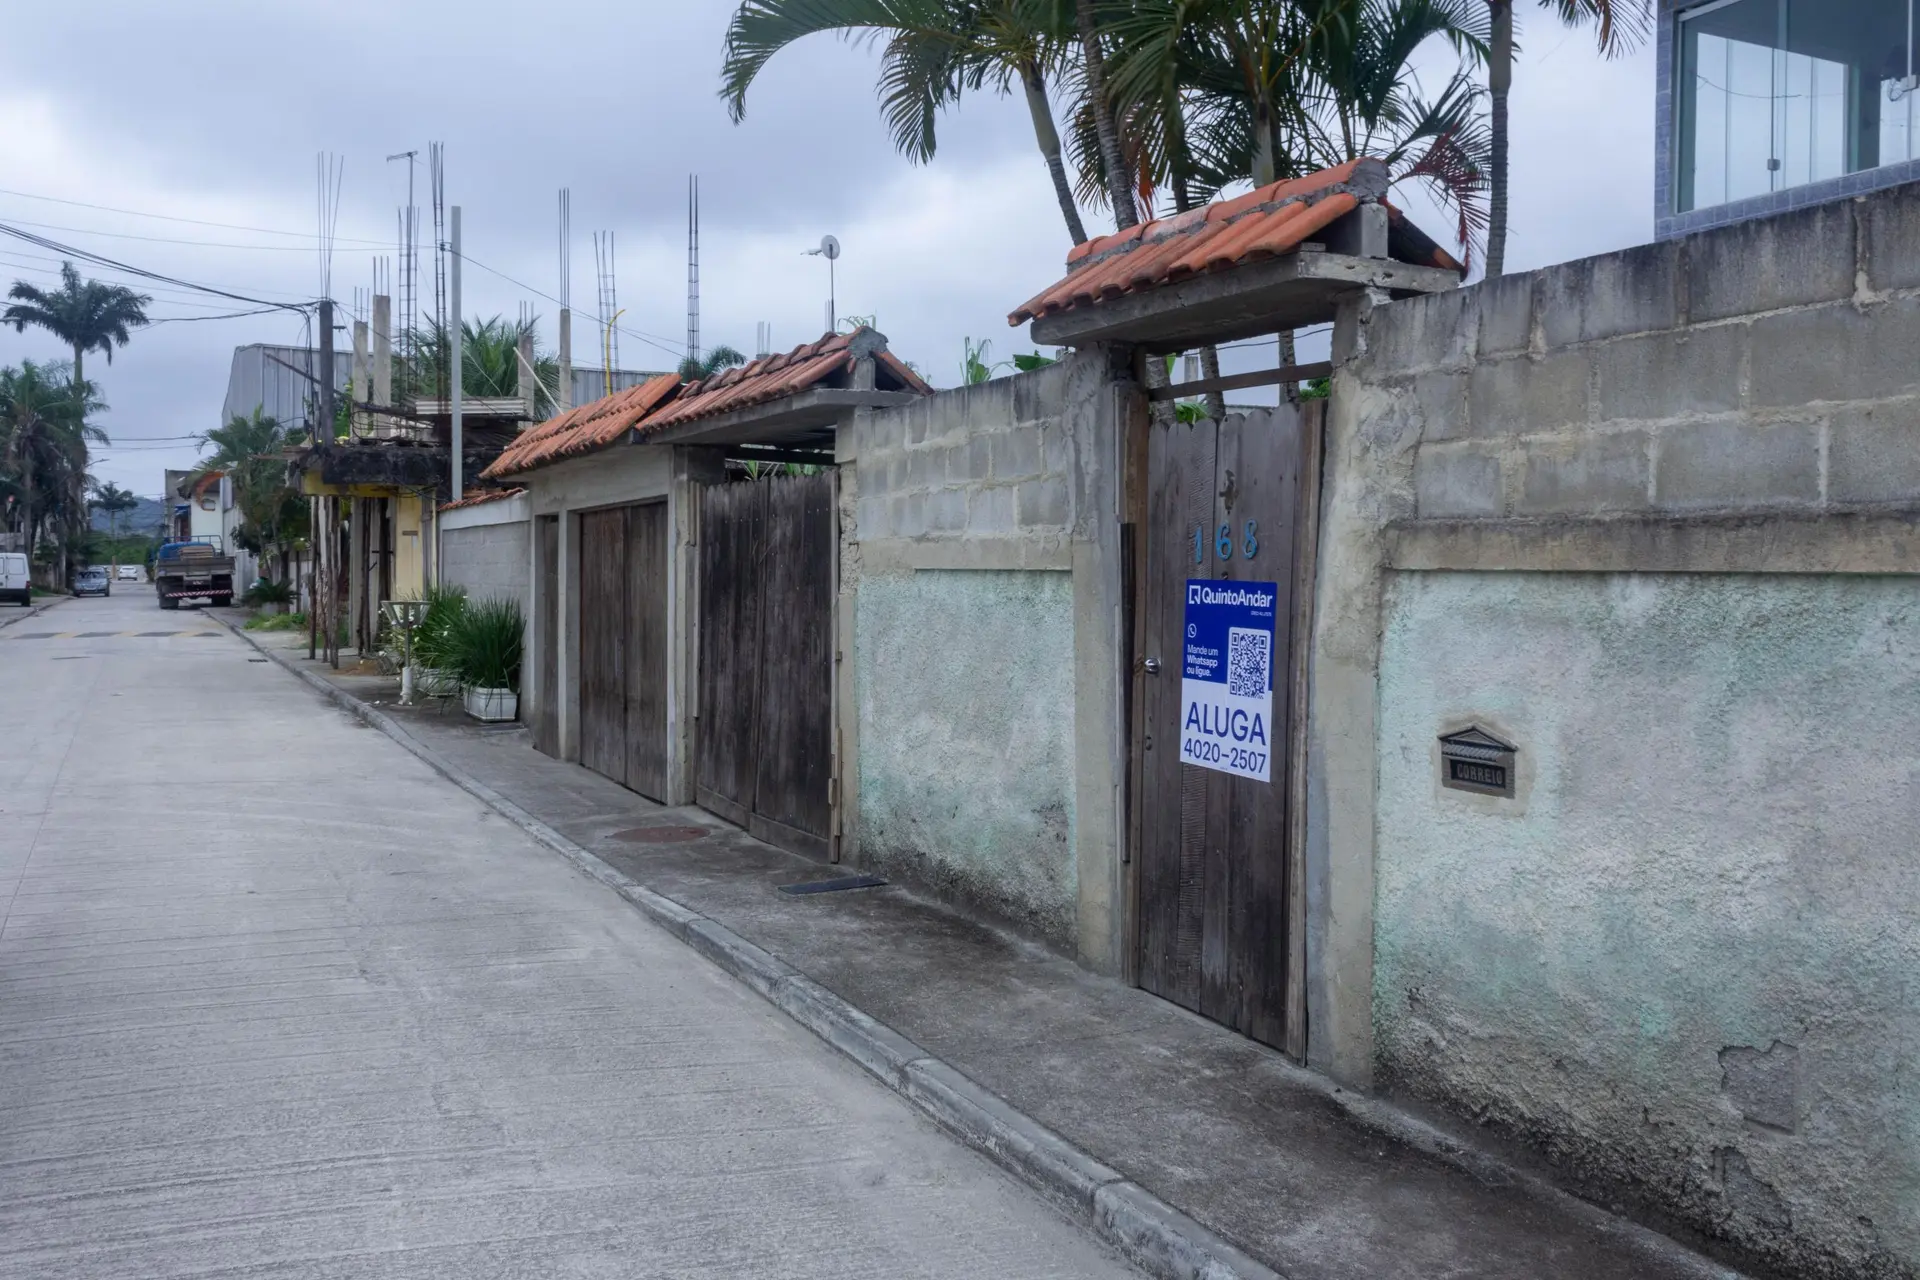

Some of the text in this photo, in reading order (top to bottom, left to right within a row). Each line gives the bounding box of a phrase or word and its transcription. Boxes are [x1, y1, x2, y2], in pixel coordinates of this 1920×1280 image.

[1195, 519, 1258, 564] 168
[1202, 587, 1273, 607] QuintoAndar
[1187, 644, 1219, 656] Mande um
[1187, 654, 1218, 668] Whatsapp
[1195, 666, 1212, 677] ligue.
[1185, 701, 1266, 746] ALUGA
[1184, 738, 1266, 773] 4020-2507
[1457, 763, 1503, 785] CORREIO
